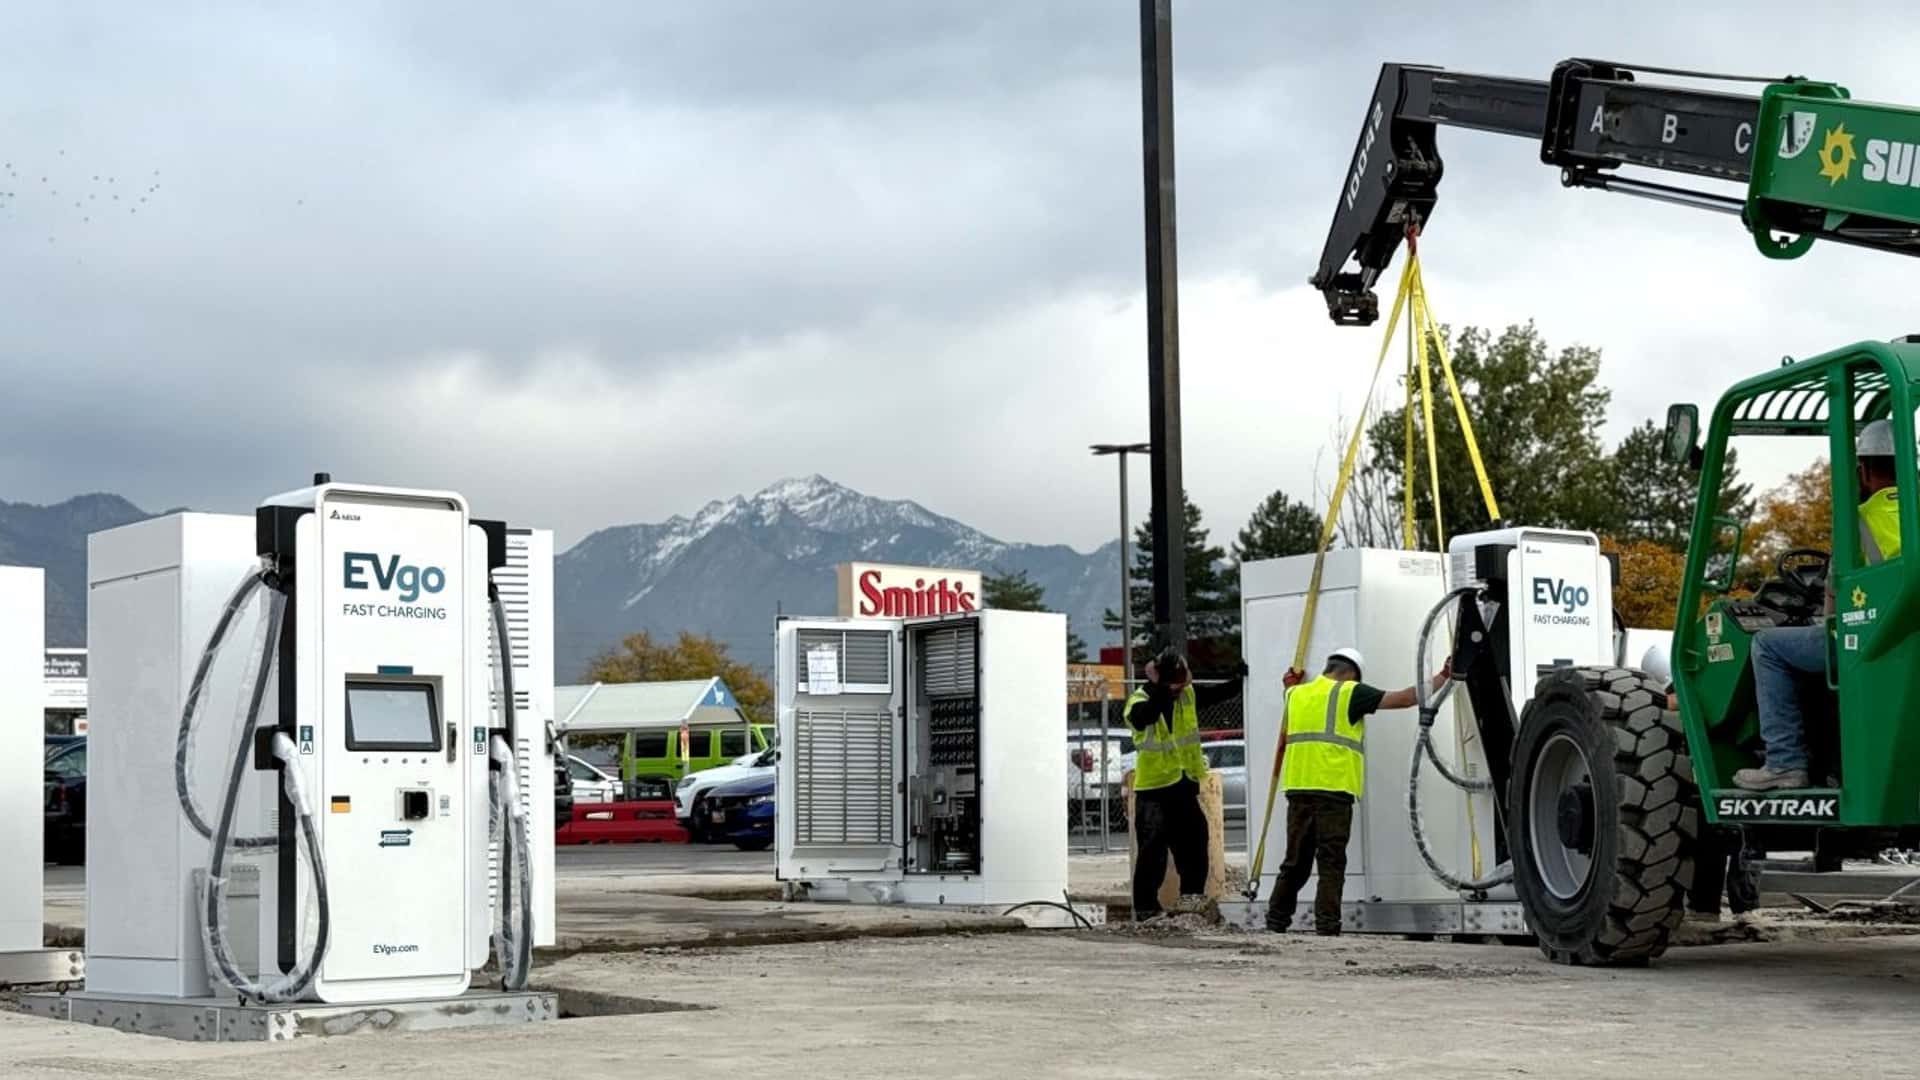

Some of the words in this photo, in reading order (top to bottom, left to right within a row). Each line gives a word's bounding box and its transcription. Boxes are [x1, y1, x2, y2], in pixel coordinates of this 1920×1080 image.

[1590, 105, 1604, 133] A
[1661, 113, 1678, 144] B
[1734, 122, 1751, 154] C
[1346, 101, 1384, 212] 10042
[343, 551, 446, 603] EVgo
[859, 570, 976, 618] Smith's
[1532, 577, 1590, 613] EVgo
[343, 603, 376, 617] FAST
[377, 605, 447, 620] CHARGING
[1533, 614, 1551, 625] FAST
[1551, 615, 1591, 627] CHARGING
[302, 742, 311, 753] A
[476, 743, 484, 753] B
[1718, 799, 1837, 817] SKYTRAK
[372, 944, 419, 956] EVgo.com
